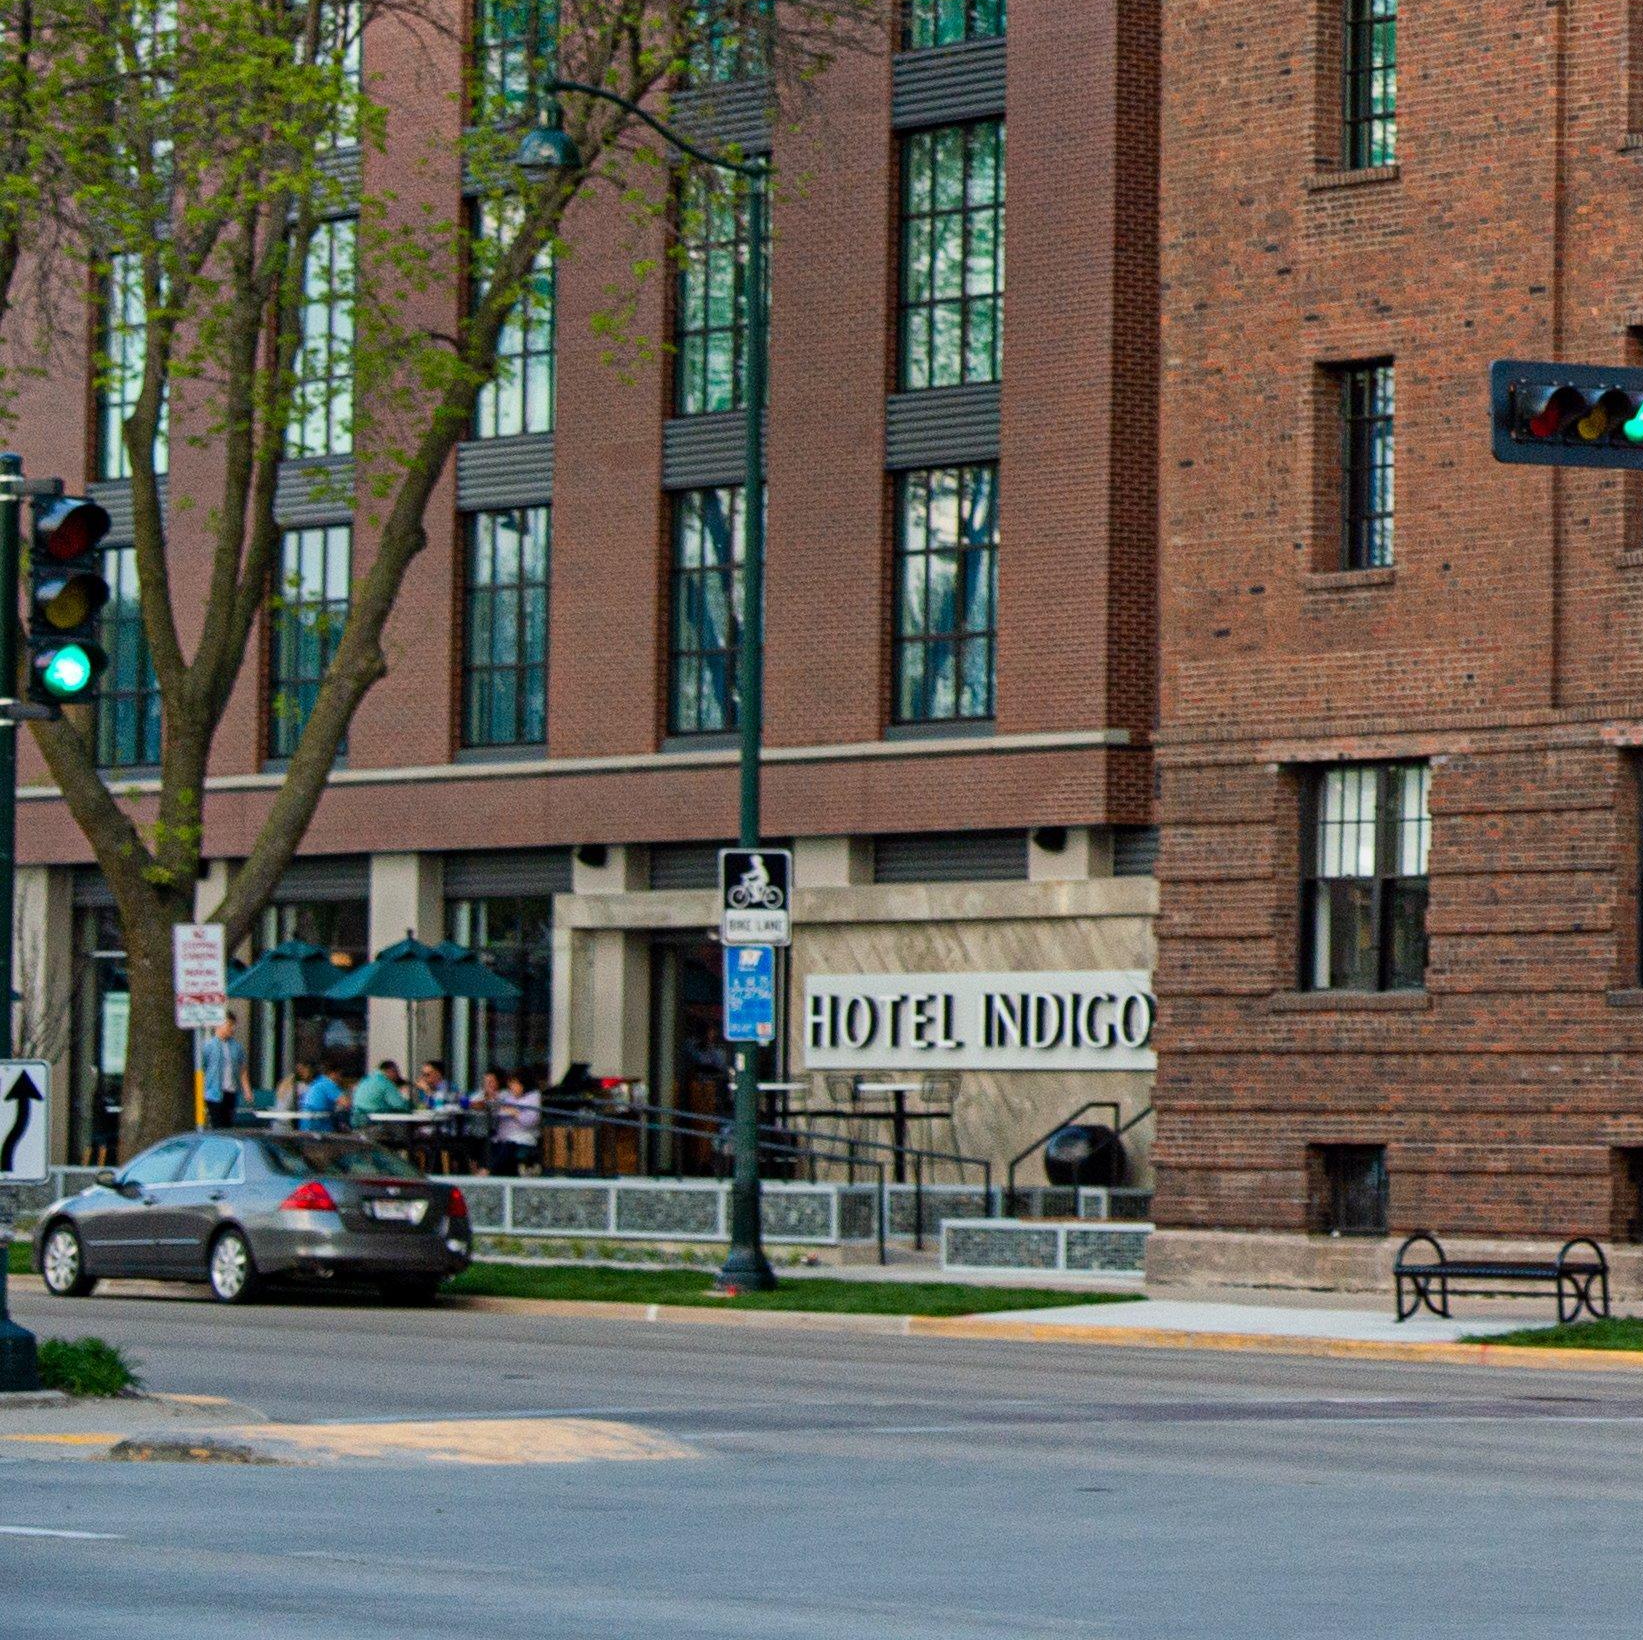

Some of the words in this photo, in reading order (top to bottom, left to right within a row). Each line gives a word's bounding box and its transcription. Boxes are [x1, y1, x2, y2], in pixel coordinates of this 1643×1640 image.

[757, 919, 783, 932] LANE
[807, 993, 963, 1049] HOTEL
[981, 992, 1156, 1049] INDIGO
